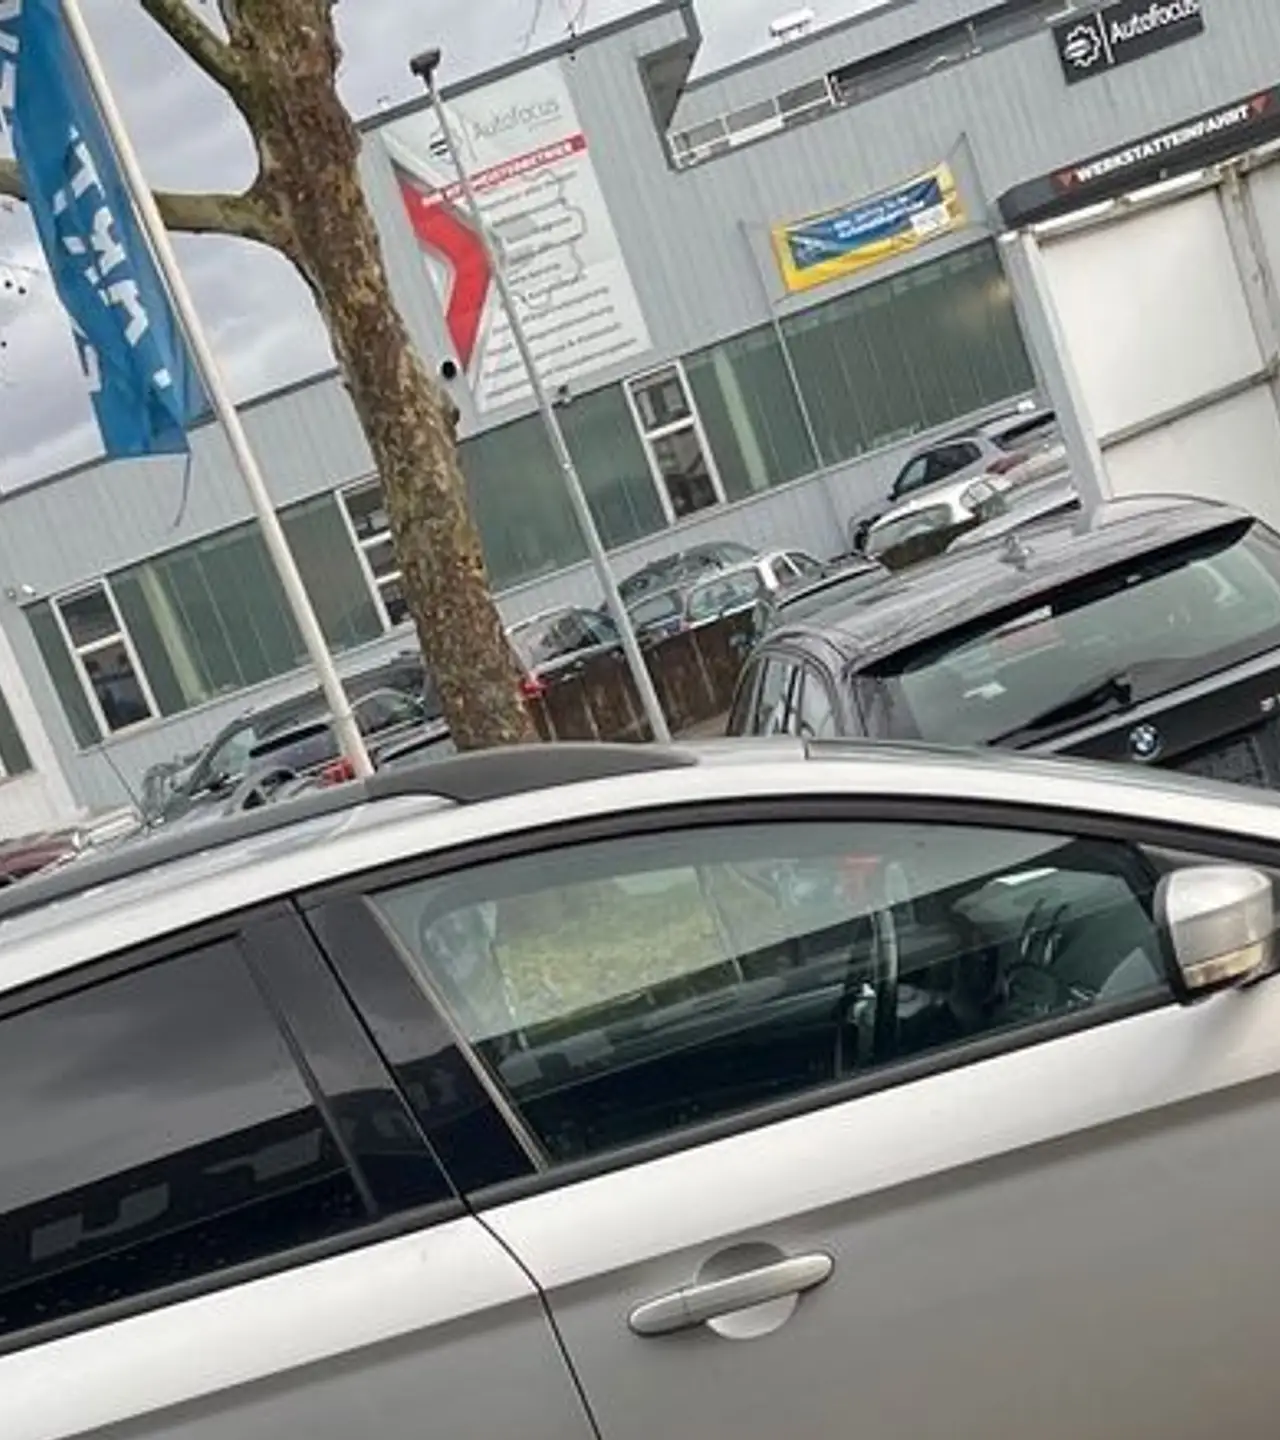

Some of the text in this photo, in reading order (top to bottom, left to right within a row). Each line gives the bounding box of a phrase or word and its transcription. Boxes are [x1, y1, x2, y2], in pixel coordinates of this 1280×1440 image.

[1111, 0, 1199, 44] Autofocus
[473, 99, 561, 140] Autofocus
[1076, 104, 1251, 183] WERKSTATTEINFAHRT
